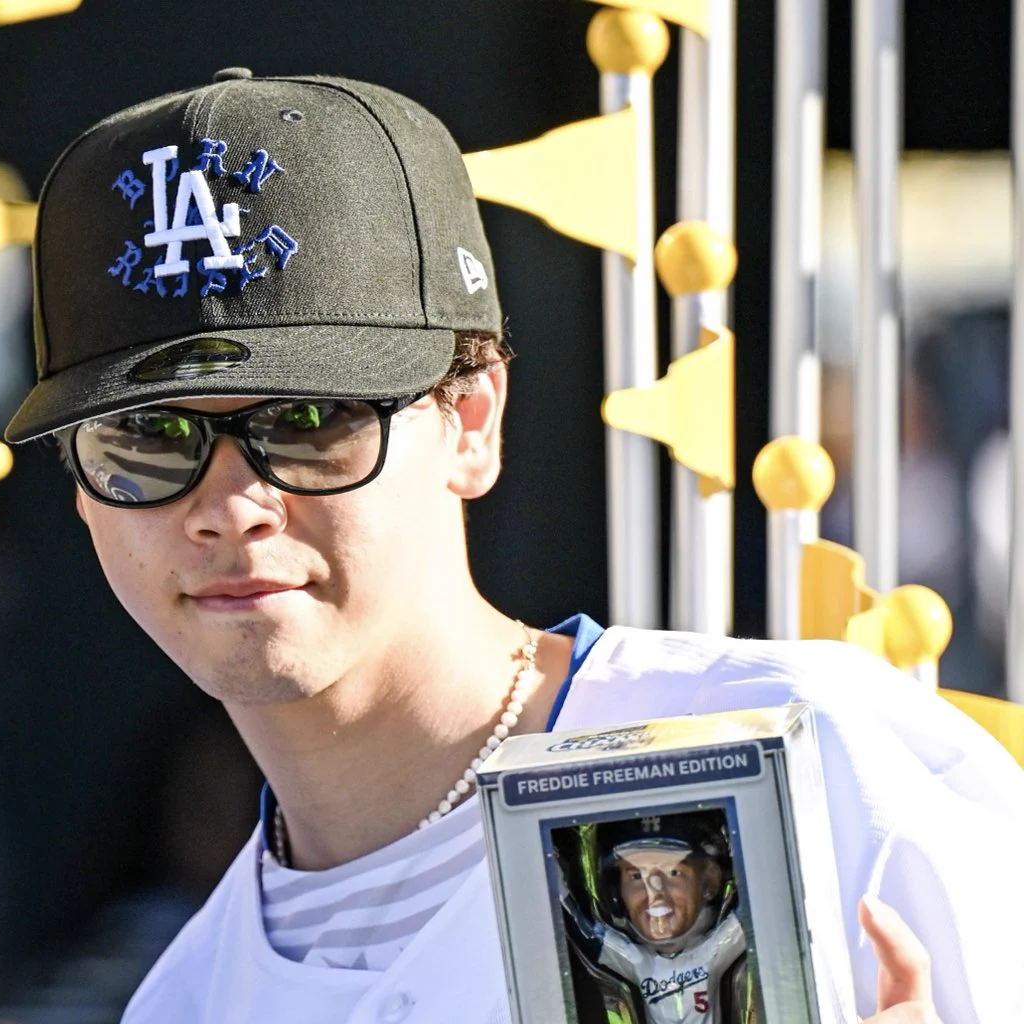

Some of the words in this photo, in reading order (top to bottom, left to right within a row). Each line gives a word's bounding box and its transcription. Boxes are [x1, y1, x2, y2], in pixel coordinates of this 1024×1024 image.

[142, 145, 242, 278] LA
[517, 774, 589, 796] FREDDIE
[593, 762, 675, 791] FREEMAN
[679, 753, 748, 775] EDITION
[641, 966, 709, 1001] Dodgers
[693, 991, 709, 1014] 5
